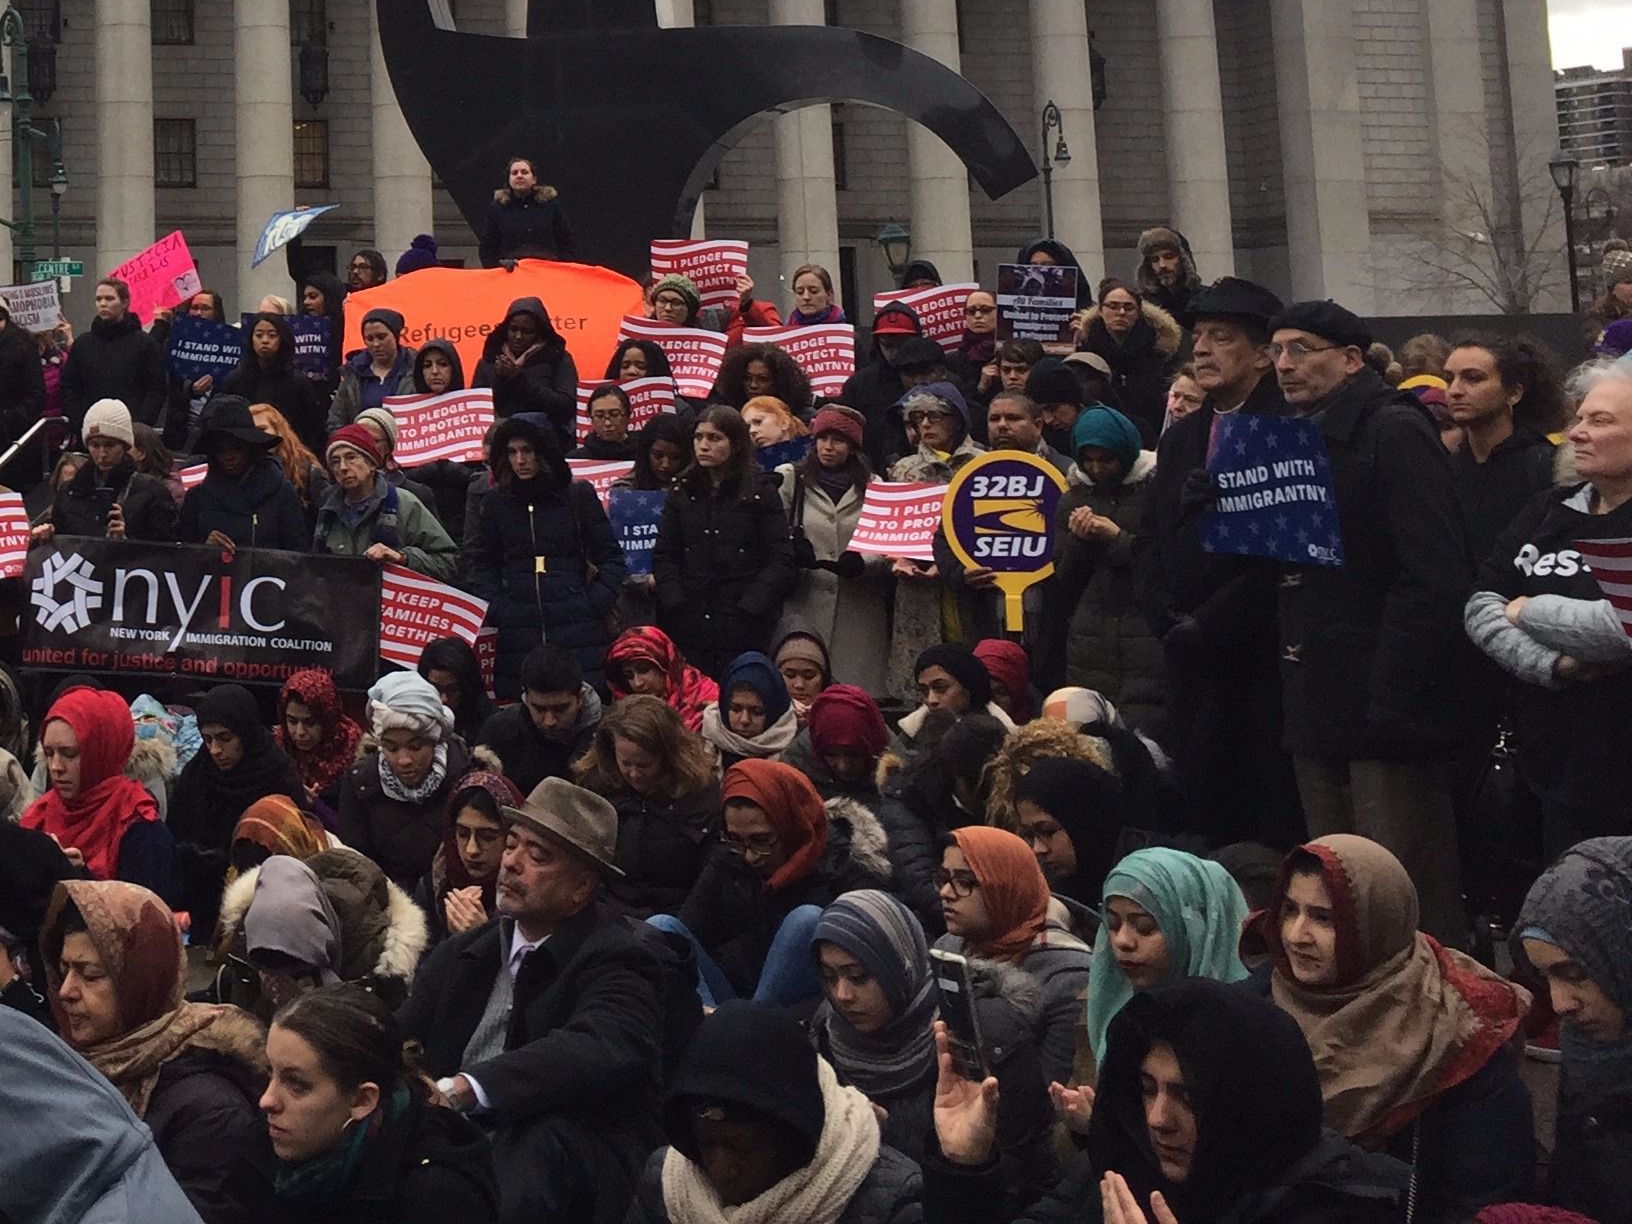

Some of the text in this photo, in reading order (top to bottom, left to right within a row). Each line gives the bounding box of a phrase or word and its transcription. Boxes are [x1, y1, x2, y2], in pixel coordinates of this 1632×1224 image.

[38, 263, 68, 275] CENTRE
[680, 251, 722, 268] PLEDGE
[912, 296, 954, 315] LEDGE
[919, 308, 965, 326] ROTECT
[294, 333, 321, 344] WITH
[400, 322, 500, 344] Refugee
[184, 341, 219, 352] STAND
[410, 402, 466, 425] I PLEDGE
[401, 414, 477, 438] TO PROTECT
[397, 426, 490, 451] IMMIGRANTNY
[1218, 459, 1316, 489] STAND WITH
[970, 476, 1045, 497] 32BJ
[894, 501, 941, 516] I PLED
[1216, 484, 1327, 513] IMMIGRANTNY
[623, 524, 659, 536] I STA
[879, 520, 898, 530] TO
[973, 537, 1047, 557] SEIU
[1513, 543, 1592, 577] Res
[112, 552, 287, 652] nyic
[396, 591, 441, 609] KEEP
[110, 627, 332, 652] NEW YORK IMMIGRATION COALITION
[21, 648, 75, 664] united
[81, 648, 107, 665] for
[112, 651, 176, 671] justice
[182, 656, 218, 674] and
